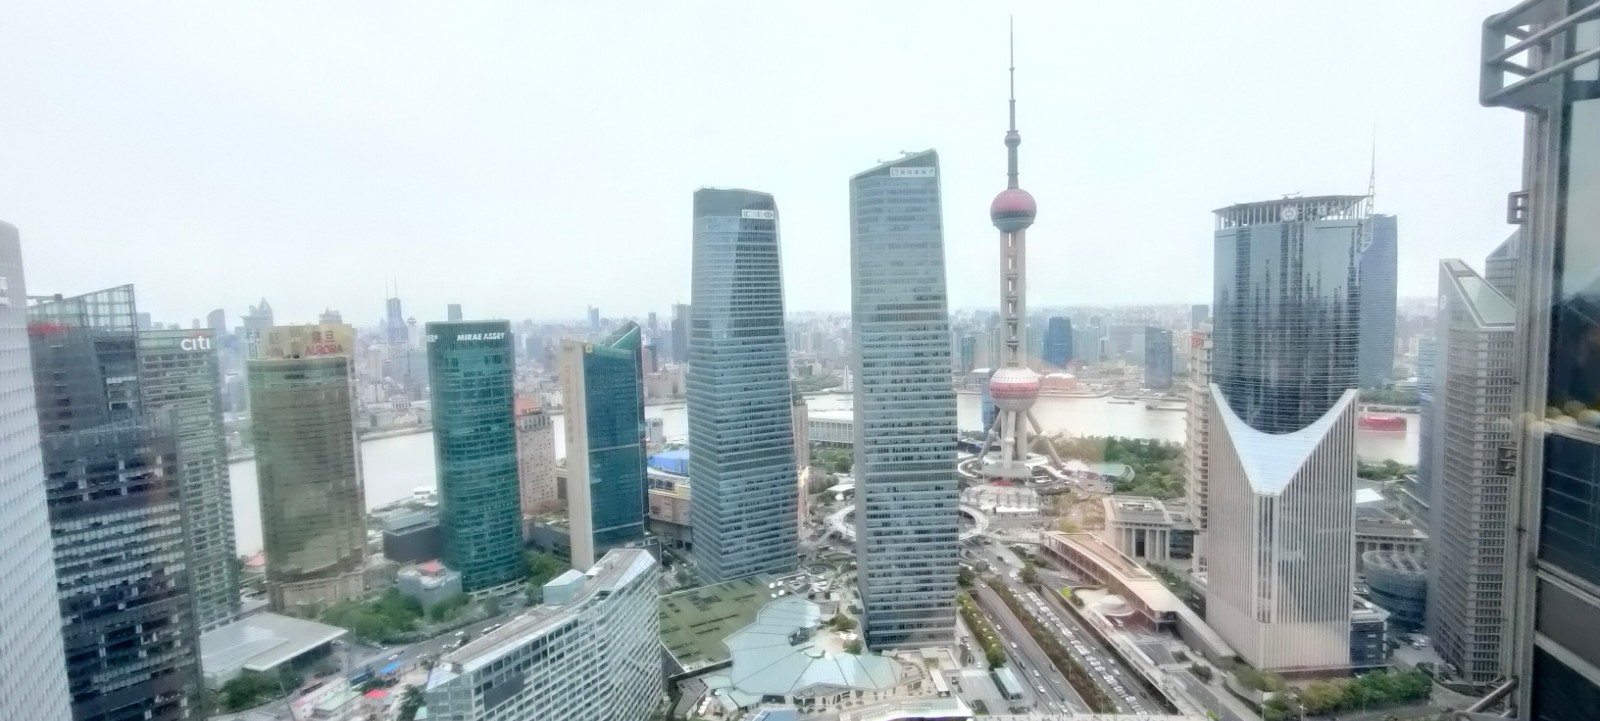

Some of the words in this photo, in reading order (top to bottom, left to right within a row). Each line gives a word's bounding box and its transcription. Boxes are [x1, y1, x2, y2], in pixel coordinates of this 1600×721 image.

[180, 334, 211, 351] citi
[456, 333, 482, 342] MIRAE
[483, 332, 505, 341] ASSET
[304, 343, 344, 355] AURORA
